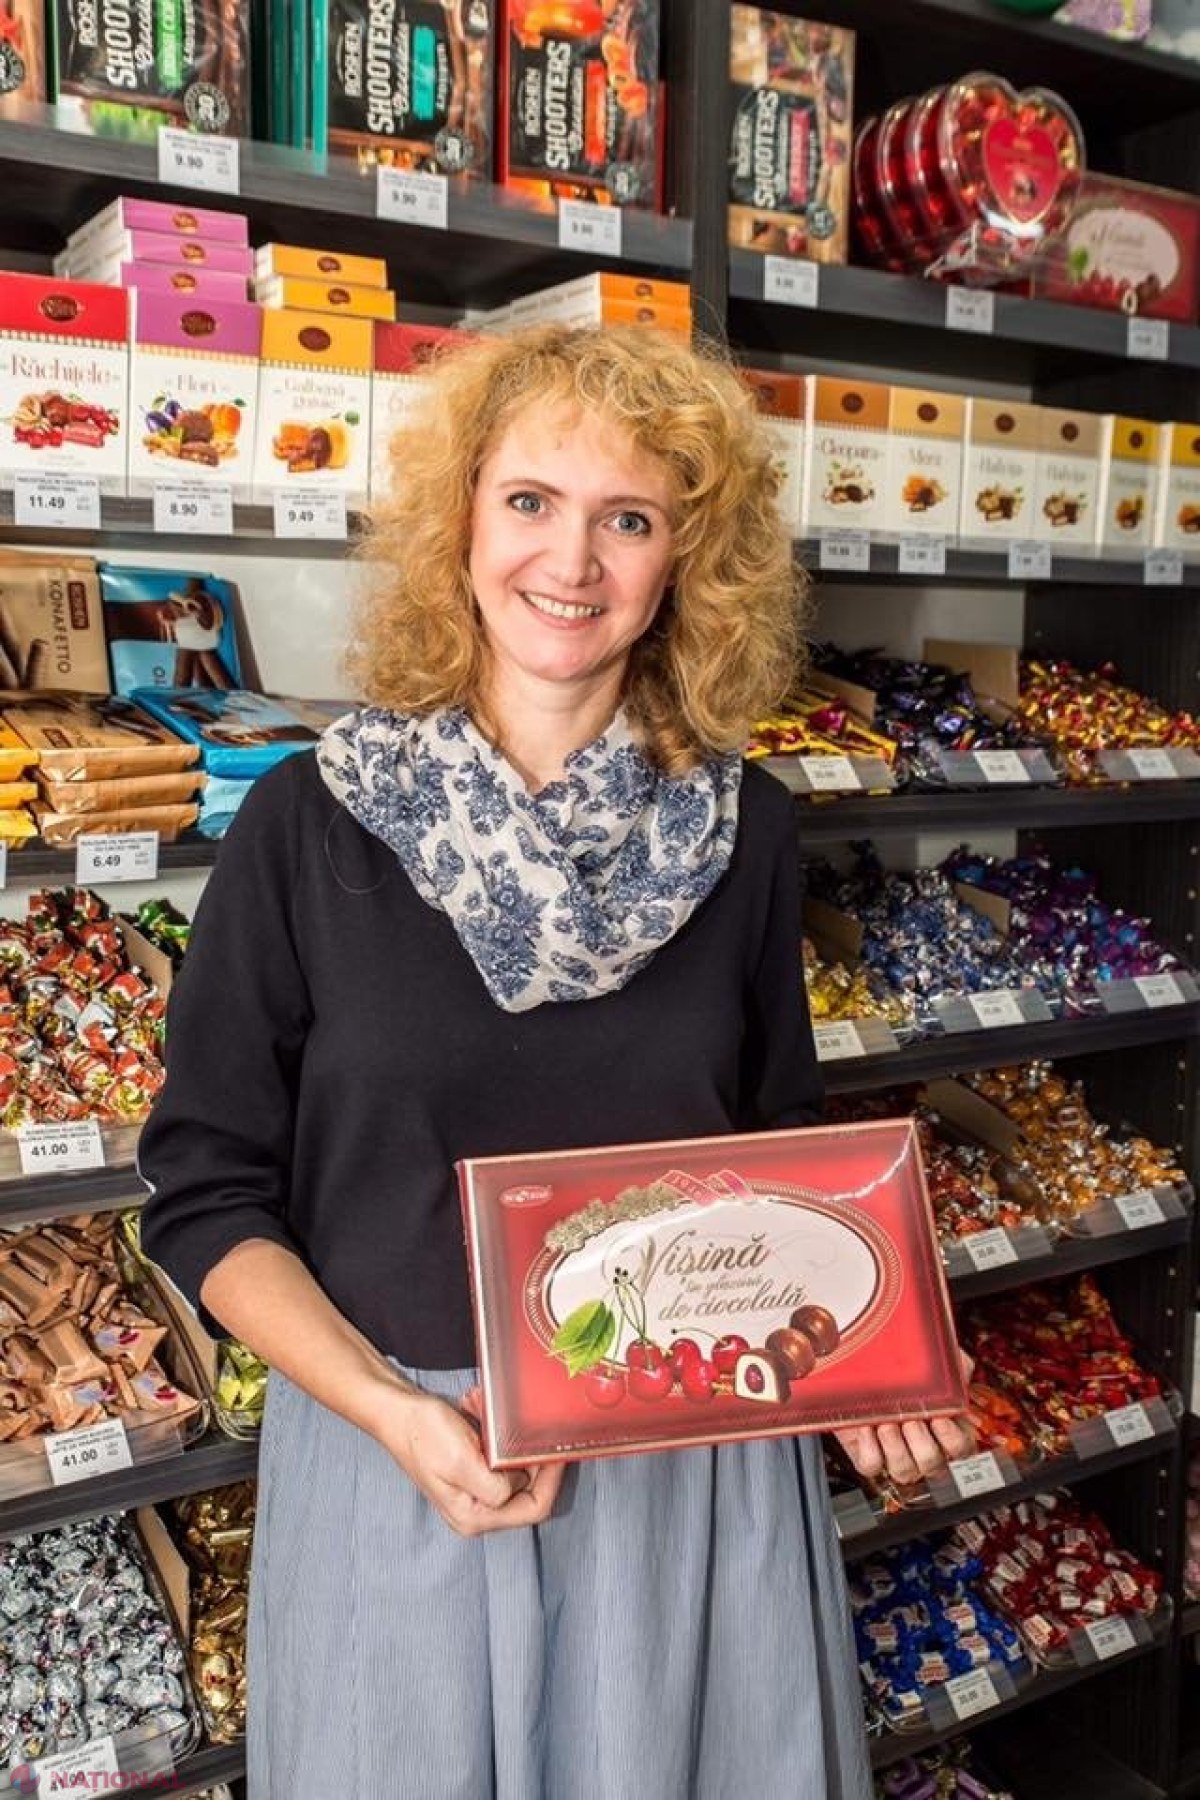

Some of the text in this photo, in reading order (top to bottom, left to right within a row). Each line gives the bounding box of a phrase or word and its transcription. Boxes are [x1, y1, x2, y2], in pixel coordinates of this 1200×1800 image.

[543, 40, 571, 170] SHOOTERS
[752, 89, 779, 209] SHOOTERS
[29, 494, 65, 509] 11.49
[288, 509, 314, 521] 9.49
[49, 580, 71, 674] KONAFETTO
[93, 854, 121, 867] 6.49
[31, 1143, 69, 1156] 41.00
[658, 1279, 806, 1321] de ciocolată
[61, 1448, 99, 1467] 41.00
